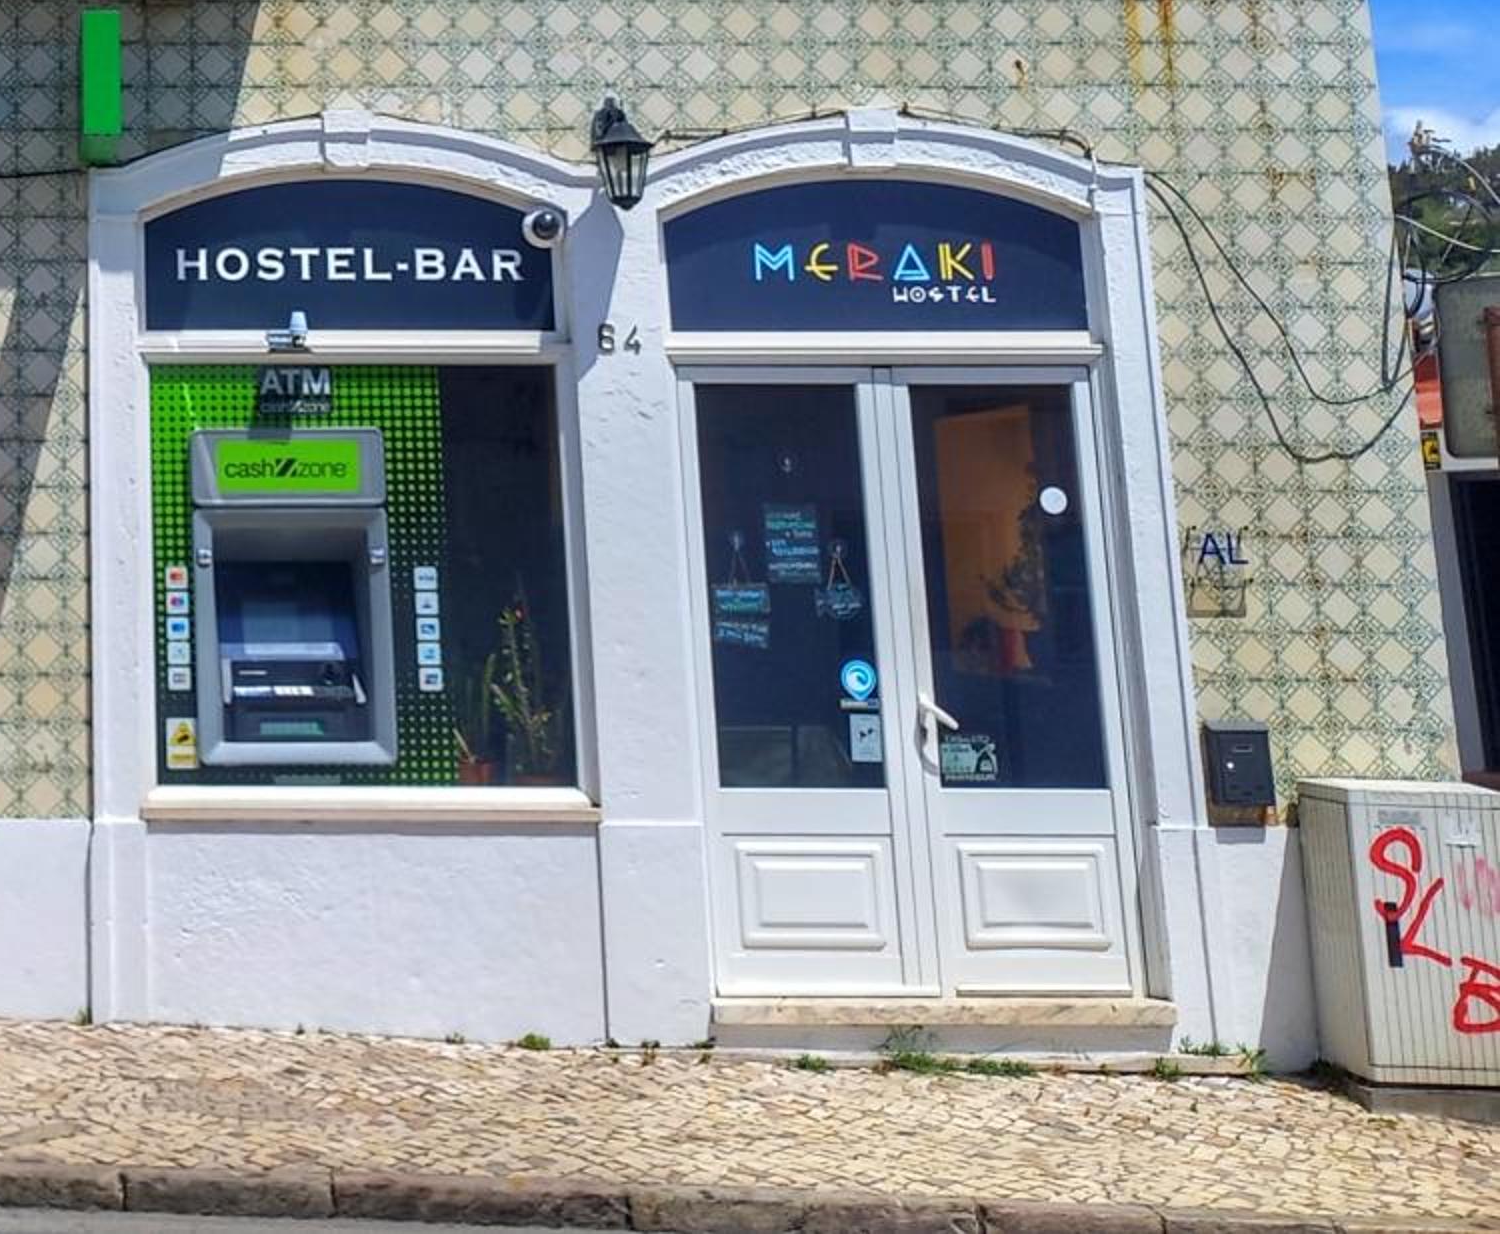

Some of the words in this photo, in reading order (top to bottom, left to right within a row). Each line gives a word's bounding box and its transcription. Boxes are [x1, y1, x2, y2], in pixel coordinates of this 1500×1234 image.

[176, 248, 524, 281] HOSTEL-BAR
[753, 243, 997, 282] MERAKI
[892, 286, 997, 303] HOSTEL
[597, 323, 642, 356] 64
[260, 368, 332, 395] ATM
[1199, 532, 1249, 564] AL
